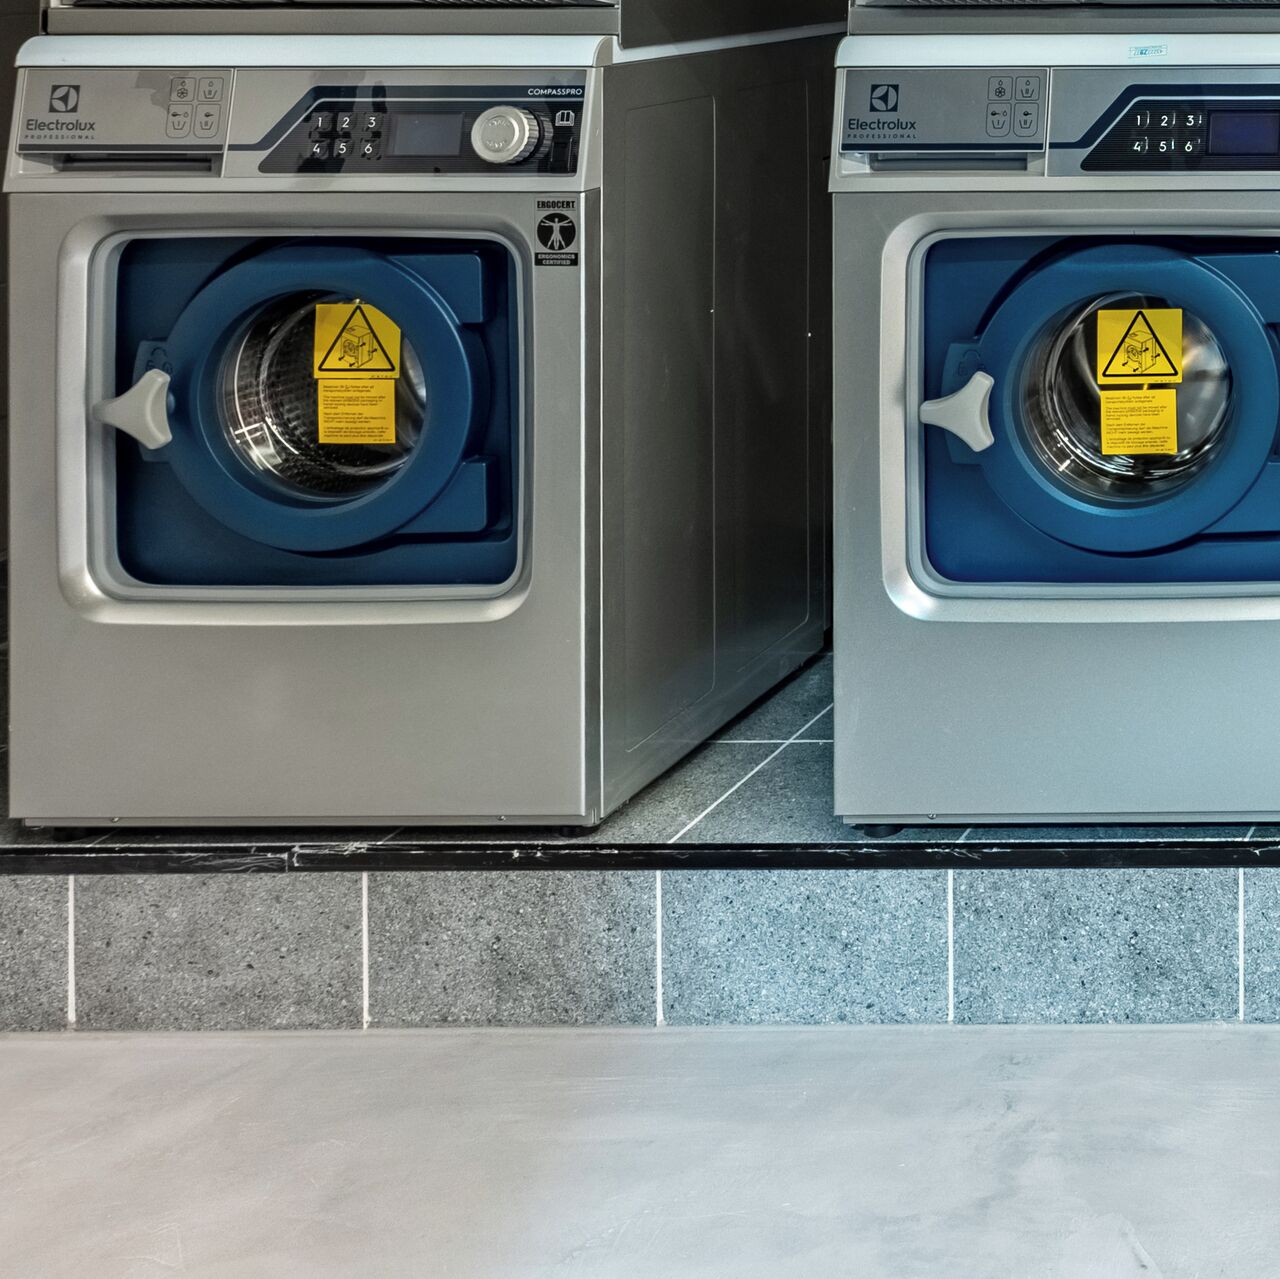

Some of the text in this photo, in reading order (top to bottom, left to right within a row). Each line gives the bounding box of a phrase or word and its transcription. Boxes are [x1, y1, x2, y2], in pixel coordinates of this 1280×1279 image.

[26, 118, 95, 132] Electrolux
[318, 116, 376, 128] 1 2 3
[847, 118, 916, 131] Electrolux
[1137, 115, 1194, 126] 1 2 3
[312, 142, 372, 154] 4 5 6
[1133, 141, 1193, 152] 4 5 6
[536, 201, 576, 209] ERGOCERT
